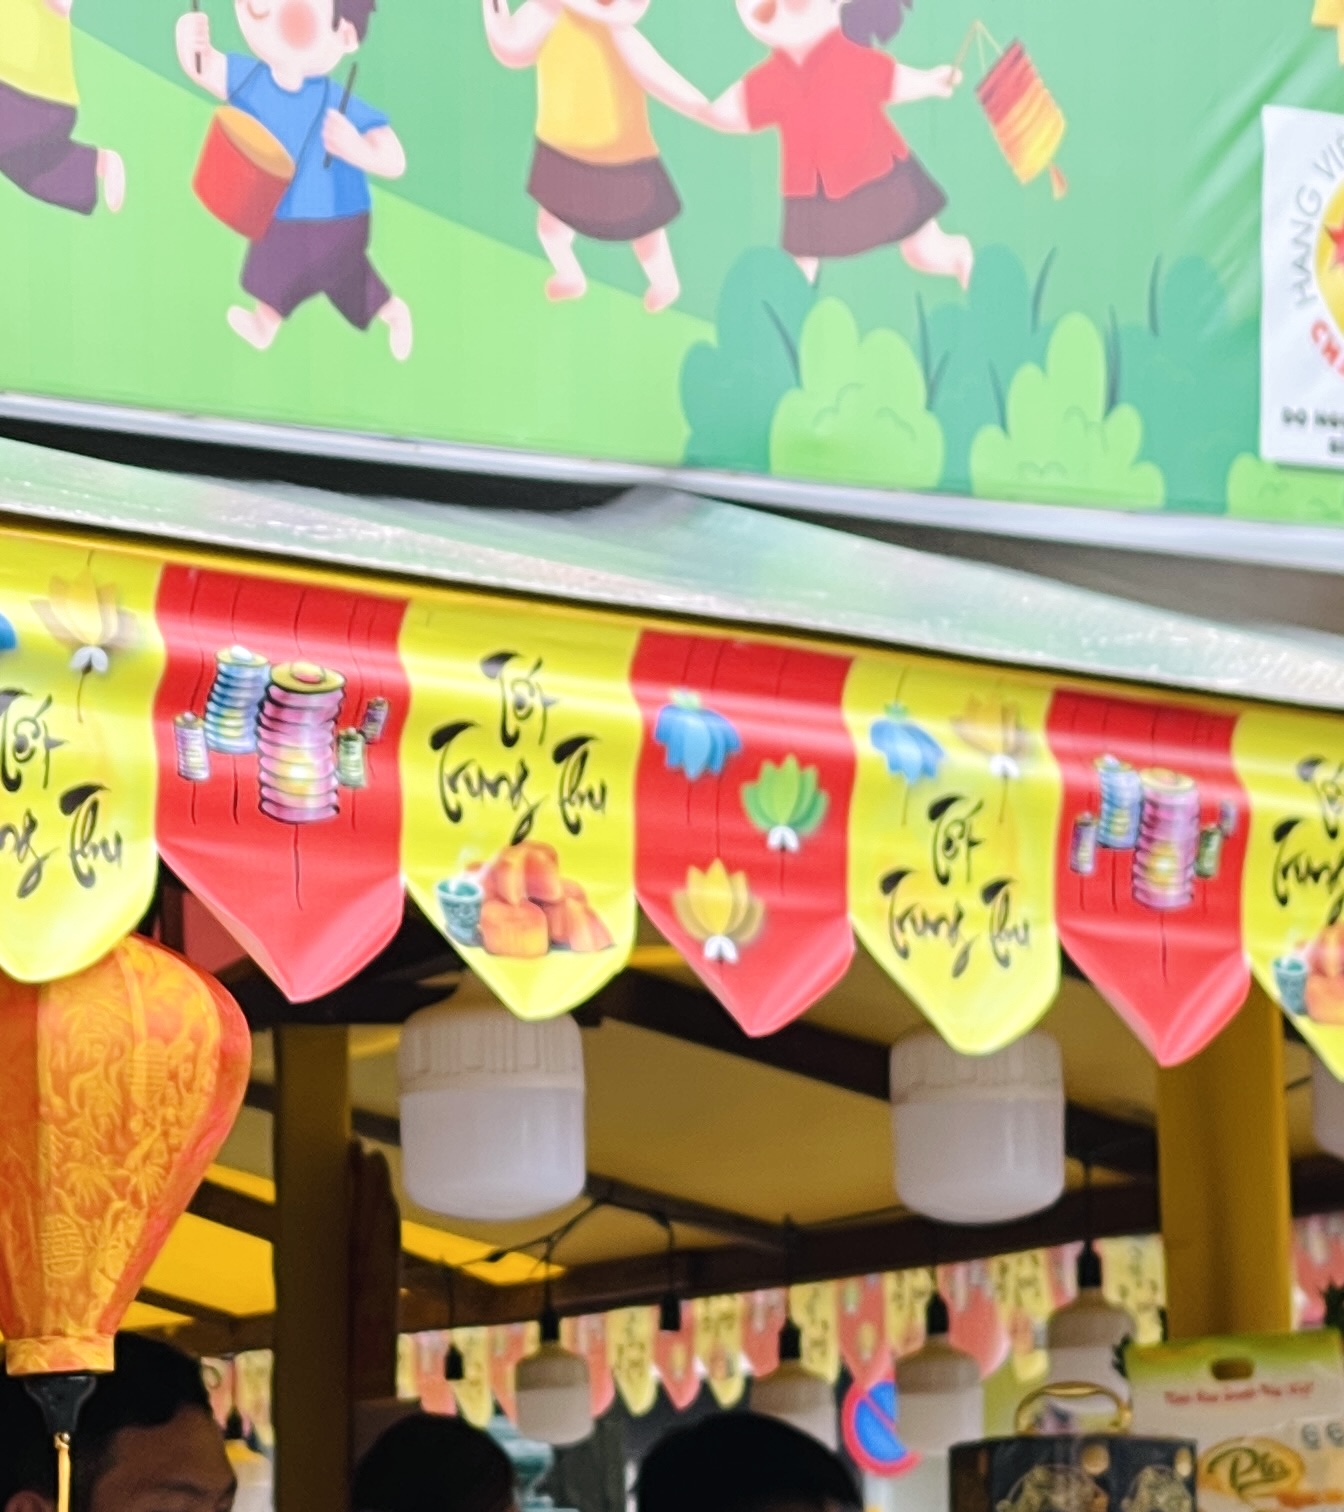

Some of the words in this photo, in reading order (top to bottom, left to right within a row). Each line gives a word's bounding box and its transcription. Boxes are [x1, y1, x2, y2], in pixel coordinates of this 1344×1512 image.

[481, 651, 557, 747] Tết
[430, 721, 551, 845] Trung
[552, 734, 606, 834] Thu
[60, 784, 123, 888] Thu
[928, 795, 983, 886] Tết
[880, 868, 976, 977] Trung
[982, 878, 1031, 967] Thu
